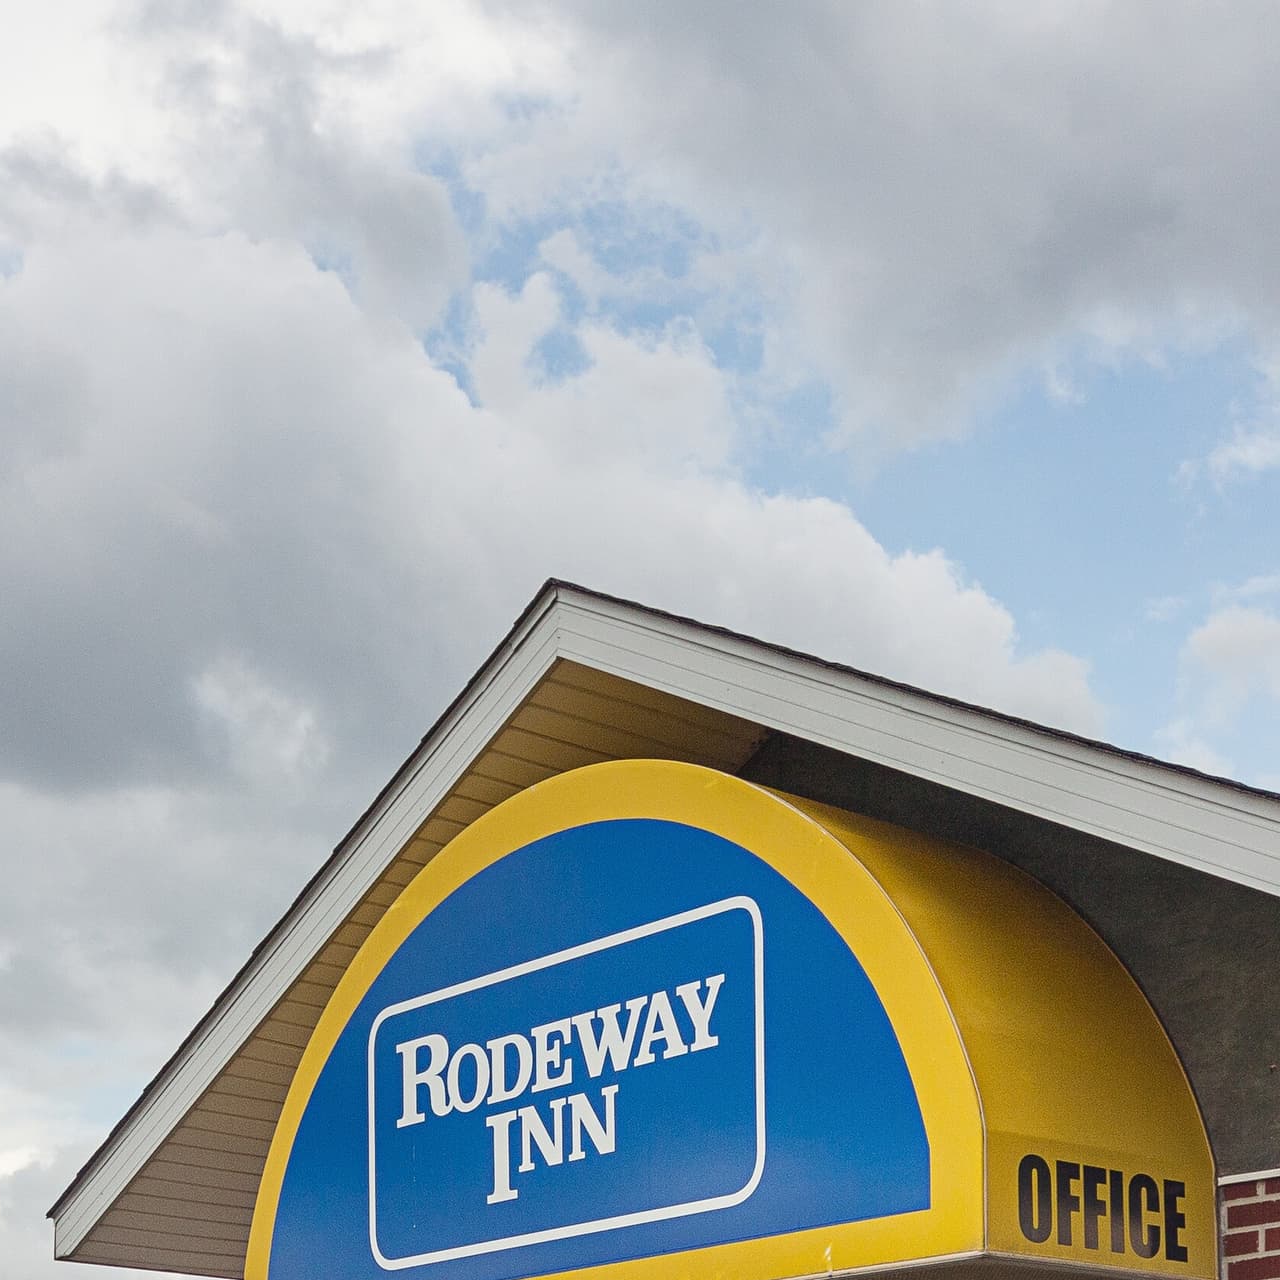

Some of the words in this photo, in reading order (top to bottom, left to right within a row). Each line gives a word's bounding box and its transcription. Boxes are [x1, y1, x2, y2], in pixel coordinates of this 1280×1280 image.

[396, 973, 726, 1130] RODEWAY
[486, 1084, 619, 1205] INN
[1018, 1154, 1188, 1263] OFFICE
